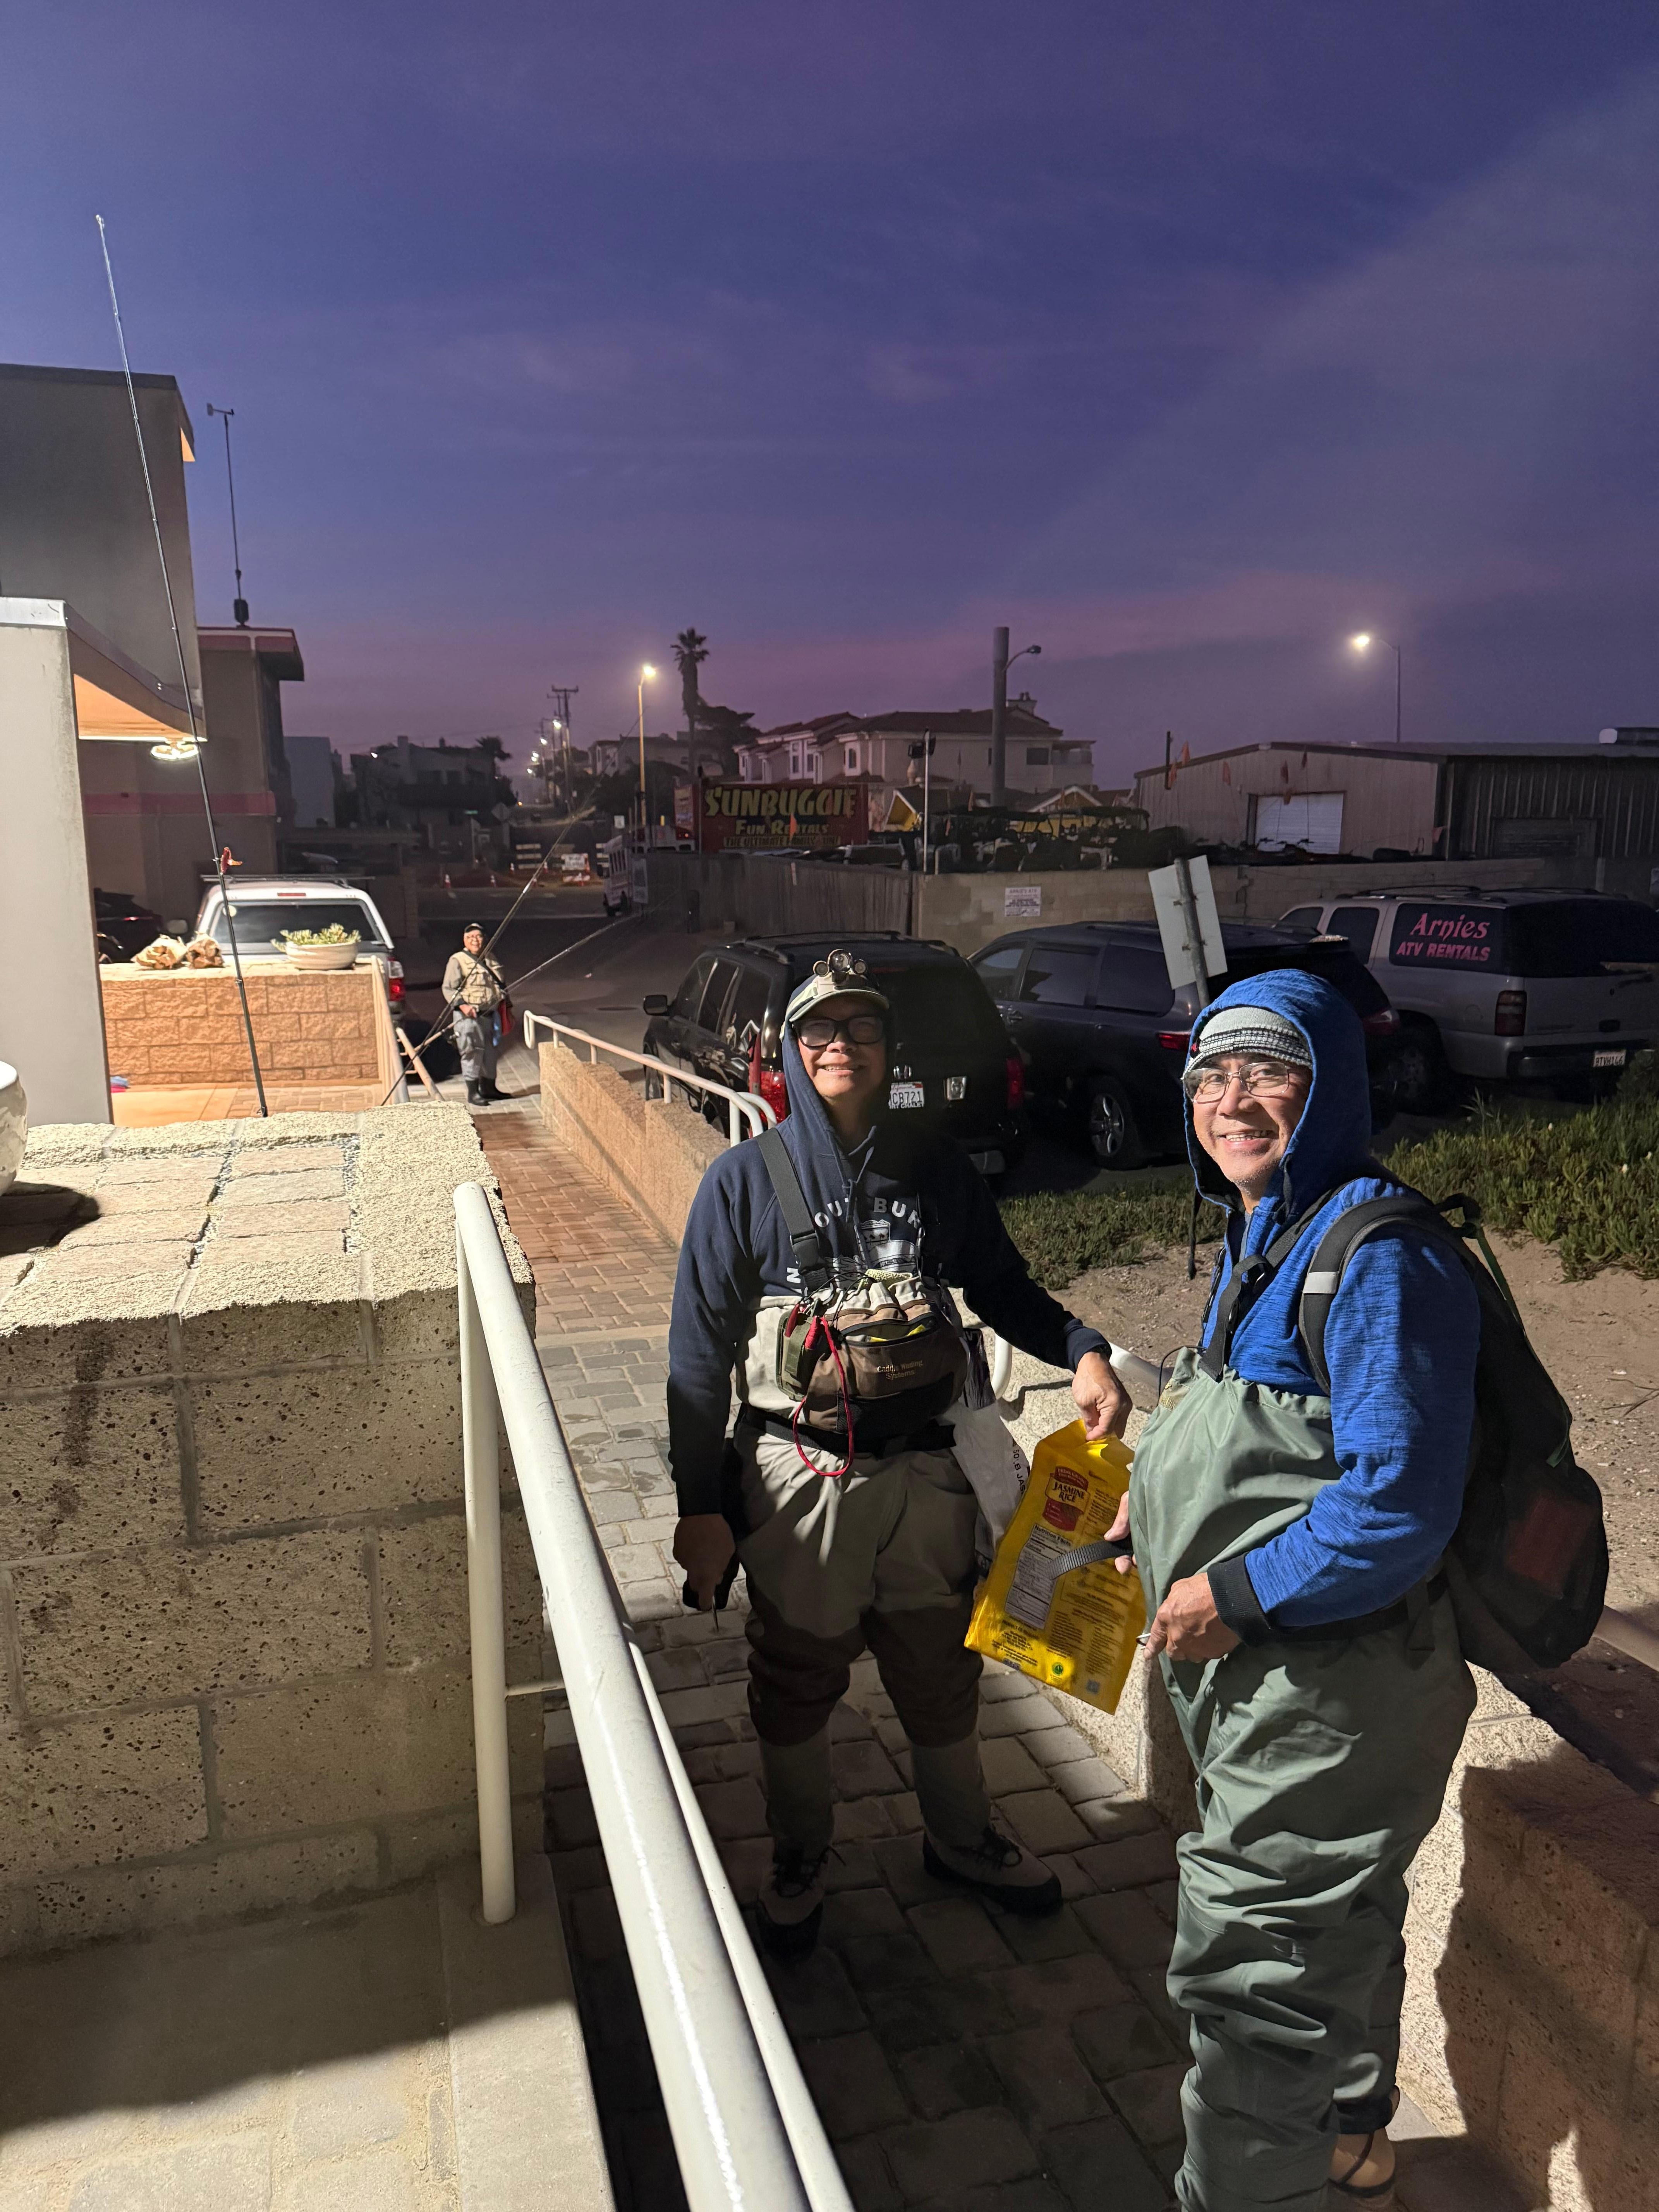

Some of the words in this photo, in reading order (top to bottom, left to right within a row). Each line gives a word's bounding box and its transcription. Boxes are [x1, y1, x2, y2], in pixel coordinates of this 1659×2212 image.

[704, 785, 857, 817] SUNBUGGIE
[1409, 913, 1491, 941] Arnies
[1396, 941, 1423, 956] ATV
[1426, 943, 1491, 962] RENTALS
[890, 1091, 922, 1105] CB721
[1051, 1482, 1085, 1499] JASMINE
[1059, 1491, 1076, 1503] RICE
